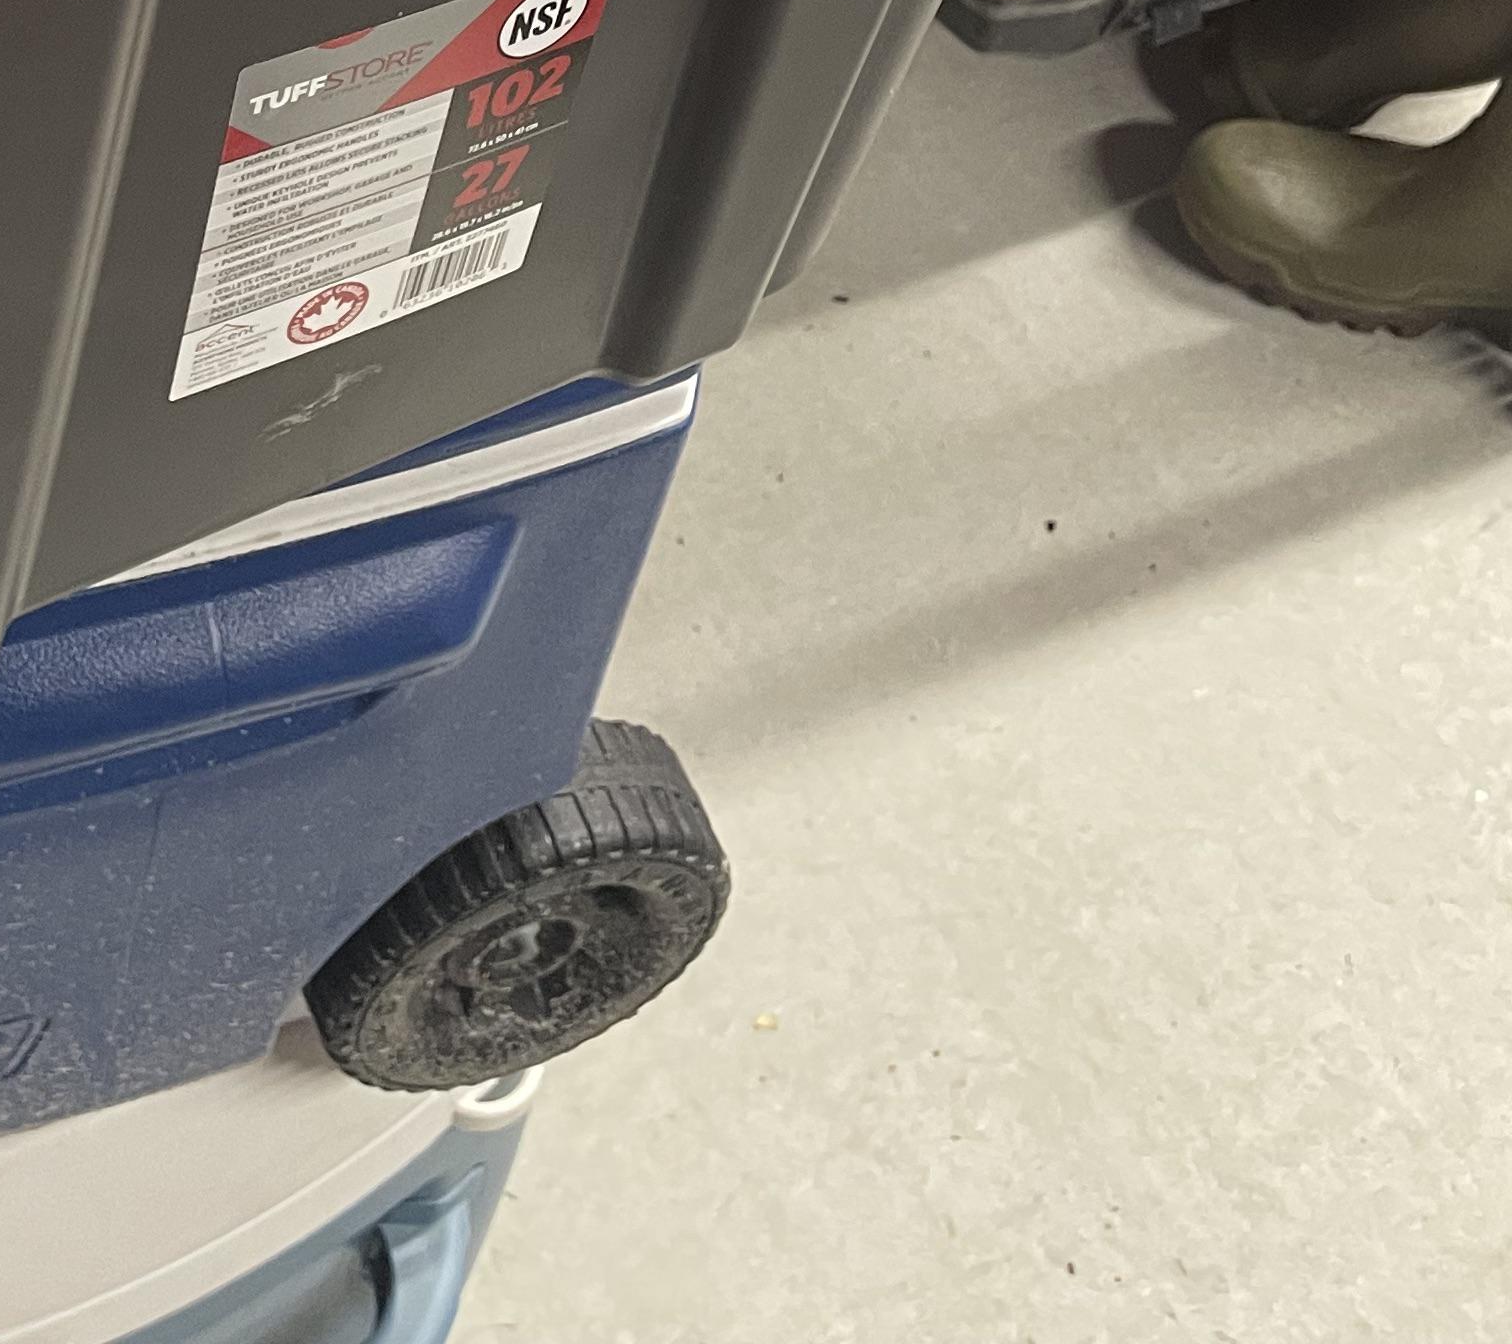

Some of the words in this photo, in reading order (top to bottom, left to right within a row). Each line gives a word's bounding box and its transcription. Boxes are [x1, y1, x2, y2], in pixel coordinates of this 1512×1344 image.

[250, 41, 433, 115] TUFFSTORE
[465, 54, 572, 129] 102
[452, 144, 531, 209] 27
